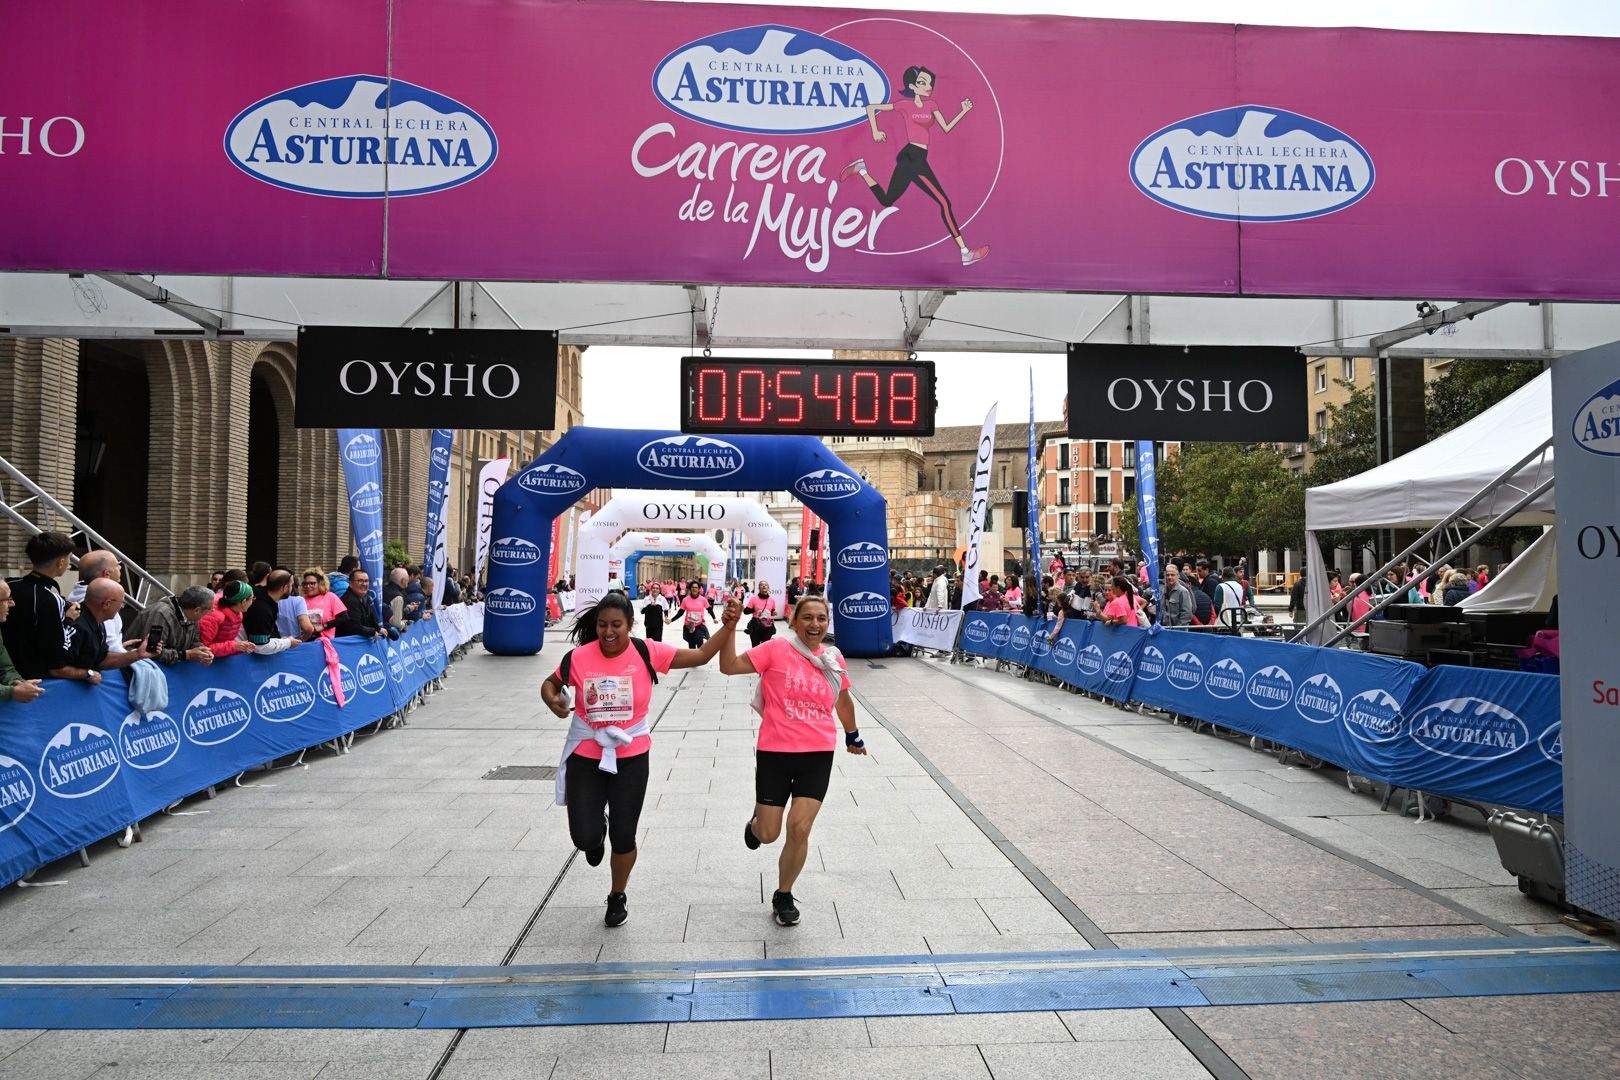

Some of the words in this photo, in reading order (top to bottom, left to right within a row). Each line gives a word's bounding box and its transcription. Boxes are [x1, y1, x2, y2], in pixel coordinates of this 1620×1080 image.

[708, 61, 784, 74] CENTRAL
[790, 64, 865, 77] LECHERA
[671, 61, 871, 108] ASTURIANA
[289, 116, 373, 129] CENTRAL
[382, 118, 469, 131] LECHERA
[245, 118, 477, 167] ASTURIANA
[631, 122, 827, 185] Carrera
[1187, 145, 1263, 156] CENTRAL
[1271, 146, 1348, 158] LECHERA
[1149, 146, 1357, 192] ASTURIANA
[1494, 157, 1620, 198] OYSH
[678, 183, 714, 222] de
[723, 184, 749, 224] la
[743, 180, 900, 273] Mujer
[339, 359, 520, 400] OYSHO
[1106, 377, 1273, 414] OYSHO
[644, 448, 736, 469] ASTURIANA
[522, 476, 580, 488] ASTURIANA
[800, 481, 857, 493] ASTURIANA
[643, 502, 725, 521] OYSHO
[491, 546, 537, 560] ASTURIANA
[840, 552, 885, 564] ASTURIANA
[842, 602, 888, 614] ASTURIANA
[912, 611, 950, 632] OYSHO
[1168, 664, 1200, 683] ASTURIANA
[1206, 671, 1240, 691] ASTURIANA
[1249, 678, 1289, 702] ASTURIANA
[1592, 680, 1618, 706] Sa
[260, 690, 312, 715] ASTURIANA
[189, 707, 248, 738] ASTURIANA
[1415, 714, 1517, 749] ASTURIANA
[57, 749, 84, 761] CENTRAL
[84, 739, 110, 752] LECHERA
[124, 728, 178, 759] ASTURIANA
[48, 748, 119, 789] ASTURIANA
